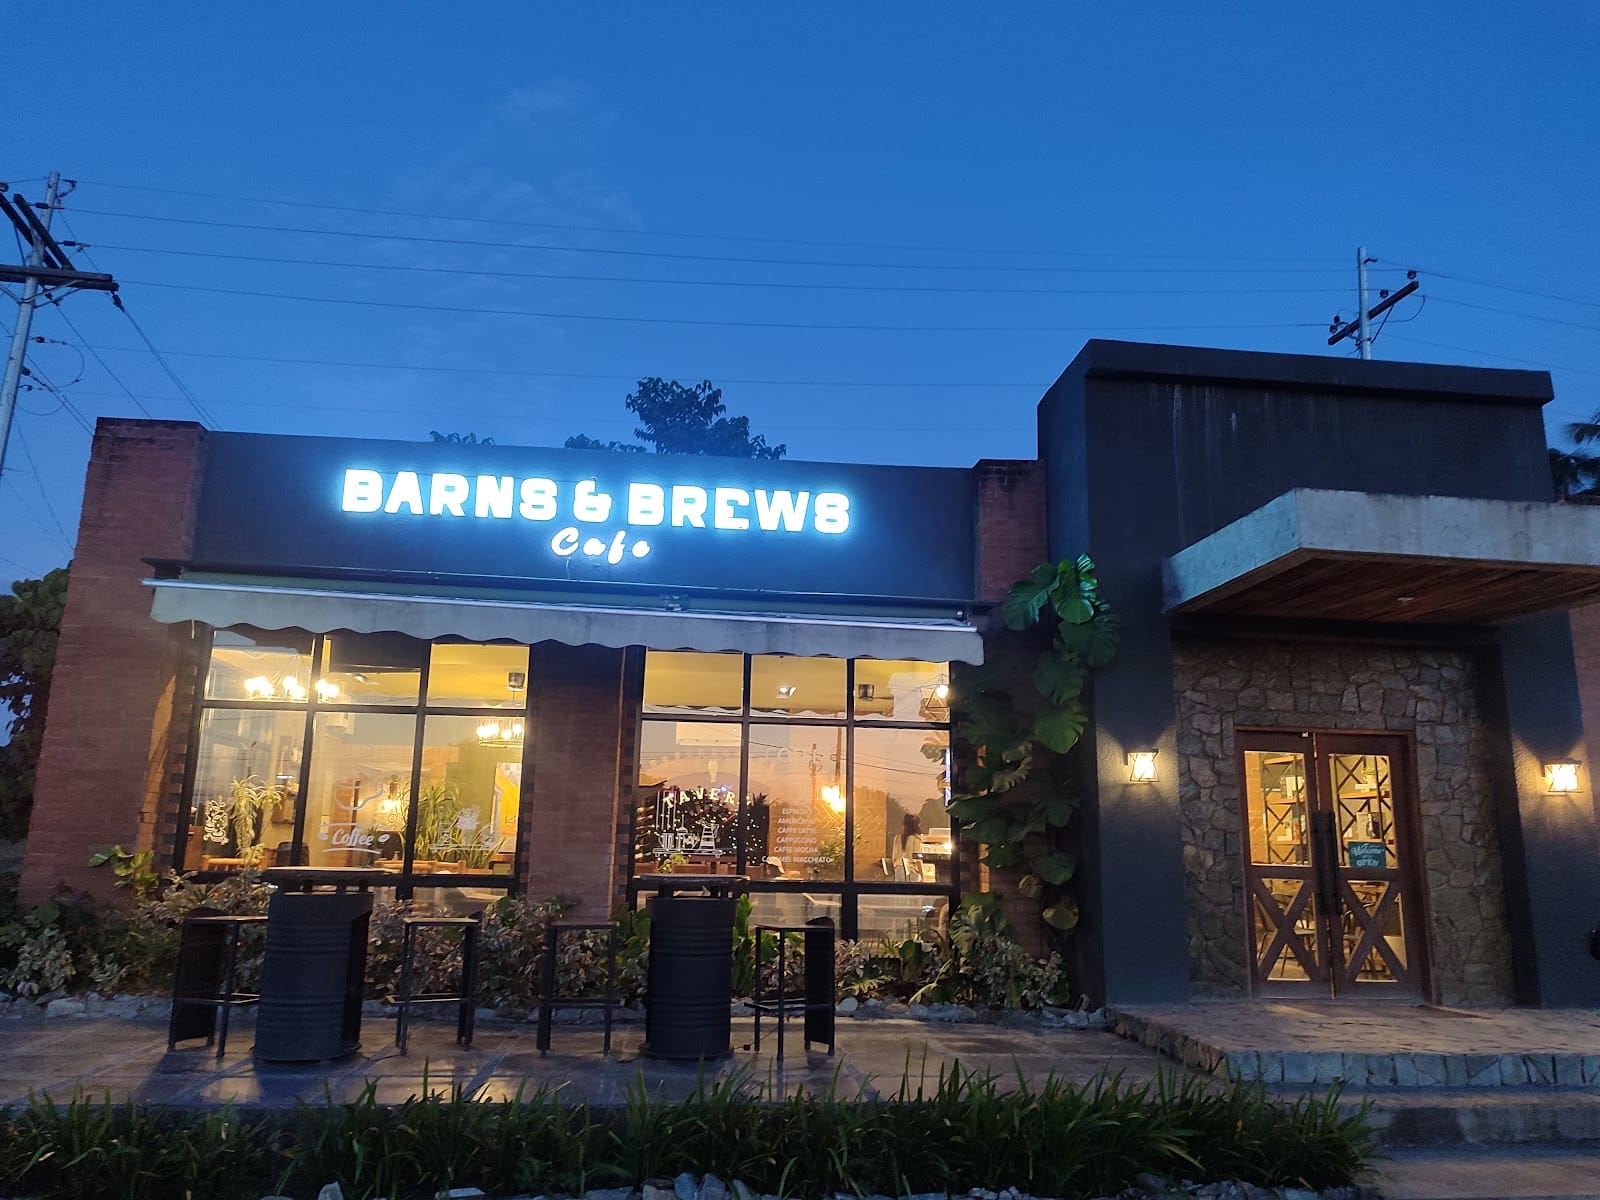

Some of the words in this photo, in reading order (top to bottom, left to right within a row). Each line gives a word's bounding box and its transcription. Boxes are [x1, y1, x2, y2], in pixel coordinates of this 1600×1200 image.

[341, 468, 558, 521] BARNS
[573, 478, 612, 523] &
[627, 482, 851, 534] BREWS
[663, 787, 751, 809] TAVER
[332, 828, 374, 847] Coffee
